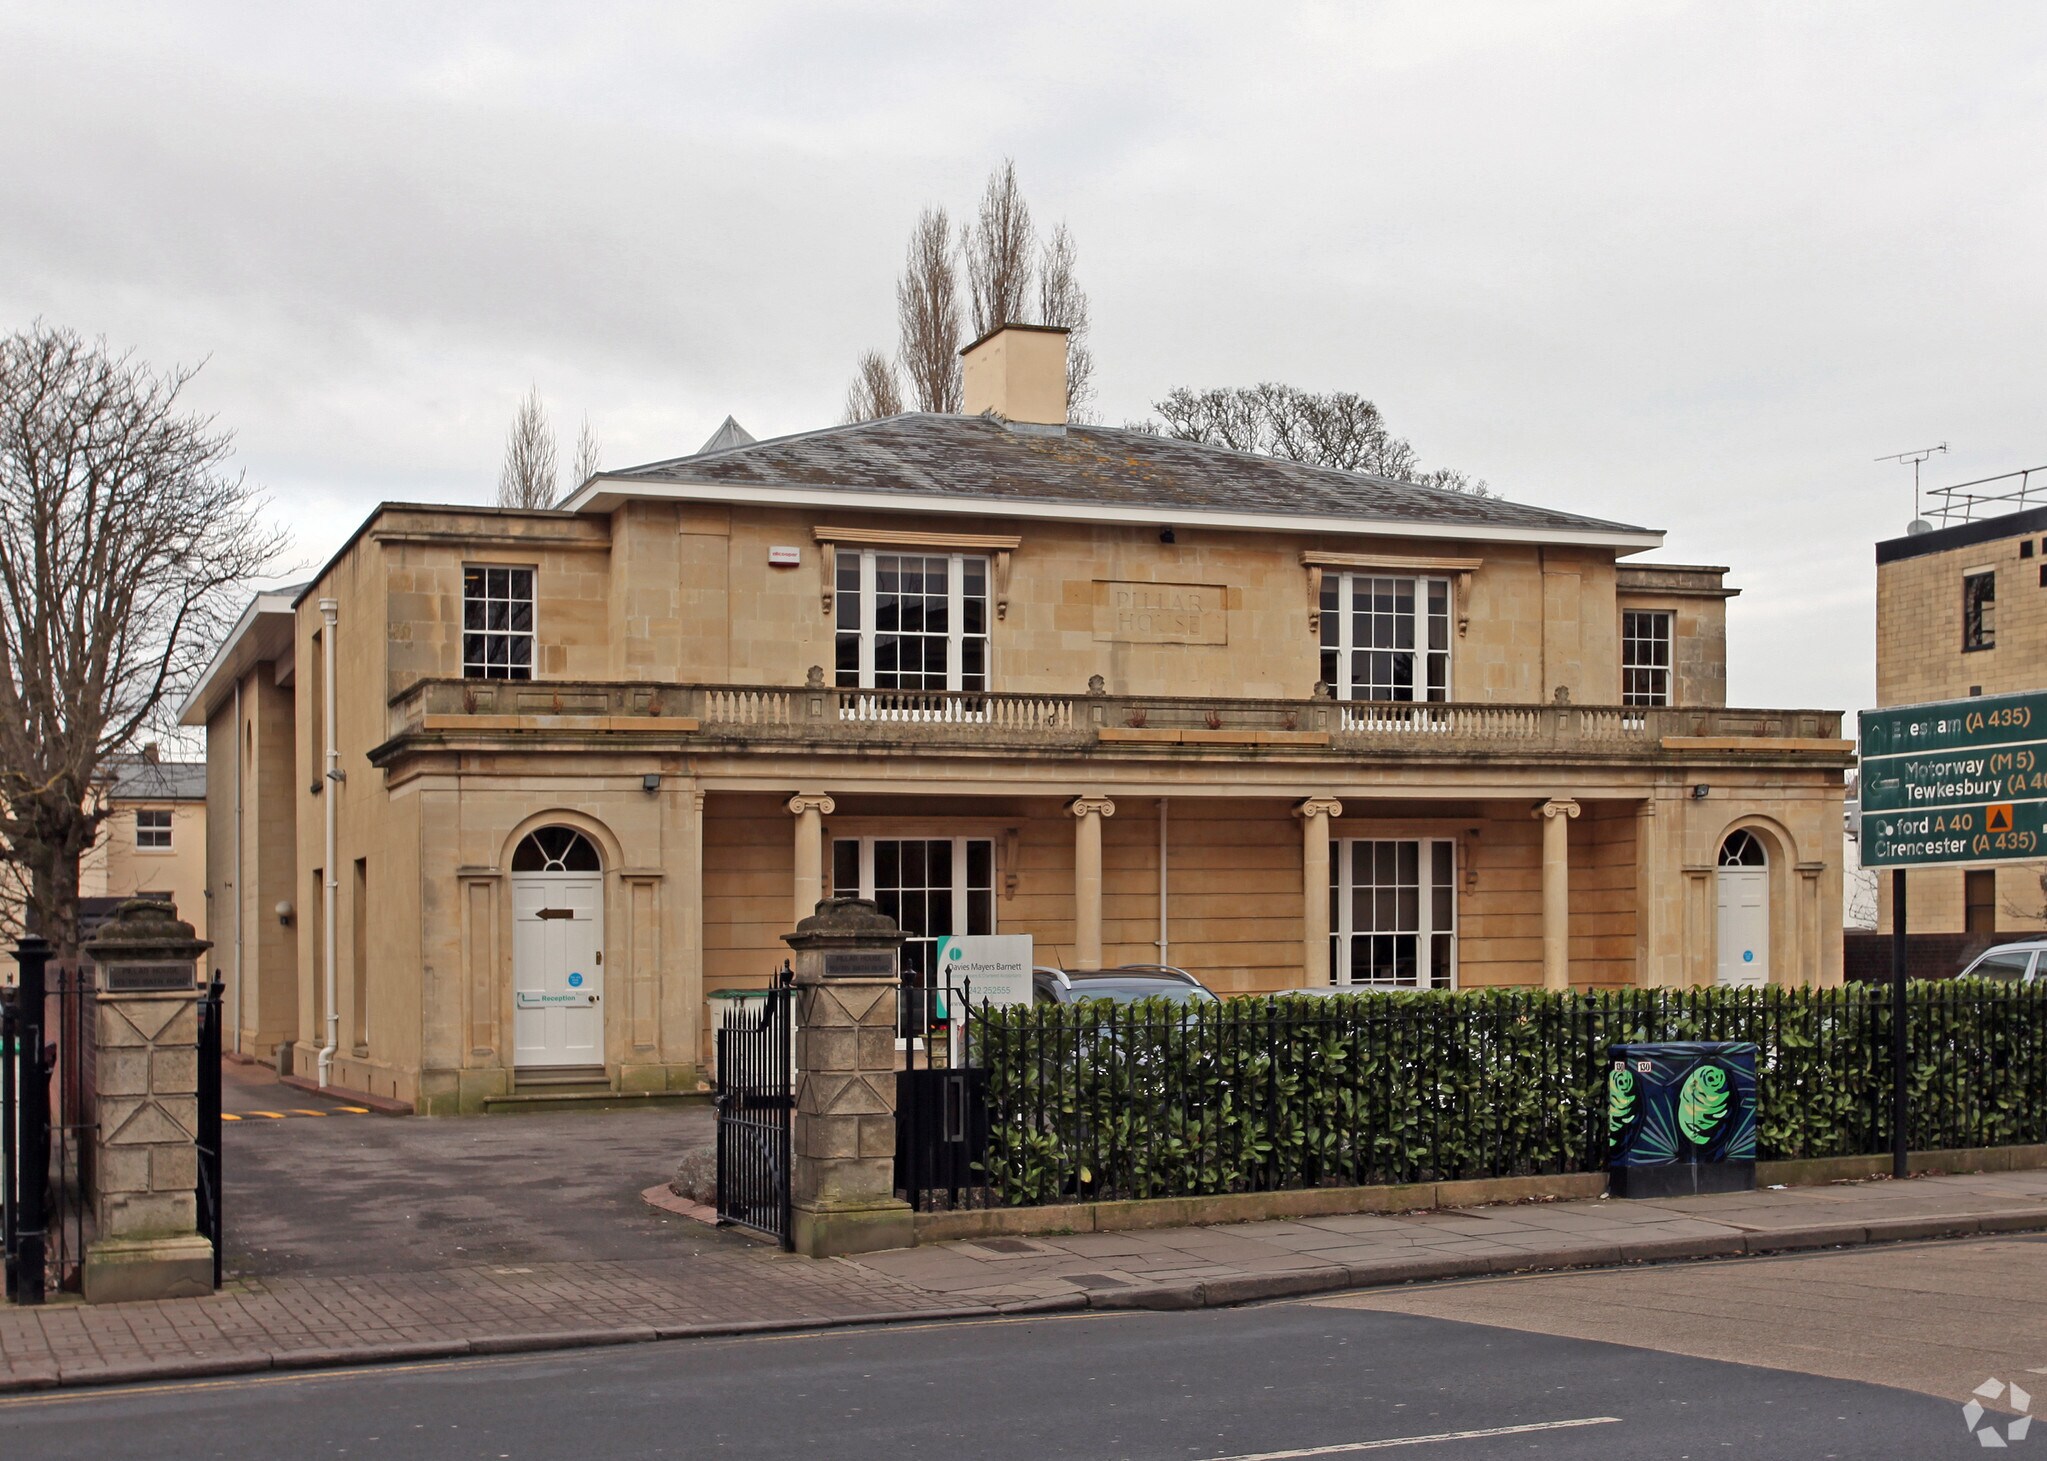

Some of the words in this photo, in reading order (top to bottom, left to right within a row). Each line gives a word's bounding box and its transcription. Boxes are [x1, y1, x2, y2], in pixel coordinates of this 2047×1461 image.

[1116, 591, 1204, 612] PILLAR
[1892, 717, 1962, 738] Eesam
[1965, 712, 1985, 734] (A
[1988, 706, 2032, 729] 435)
[1904, 759, 1985, 780] Motorway
[1990, 752, 2013, 775] (M
[2016, 749, 2036, 772] 5)
[1905, 778, 2002, 800] Tewkesbury
[2007, 773, 2027, 795] (A
[1875, 816, 1929, 837] Oford
[1934, 815, 1946, 833] A
[1949, 813, 1973, 832] 40
[1875, 837, 1967, 858] Cirencester
[1972, 833, 1990, 855] (A
[1994, 831, 2038, 853] 435)
[949, 963, 970, 971] Davies
[970, 962, 998, 973] Mayers
[997, 962, 1022, 971] Barnett
[960, 986, 982, 995] 0242
[983, 986, 1011, 995] 252555
